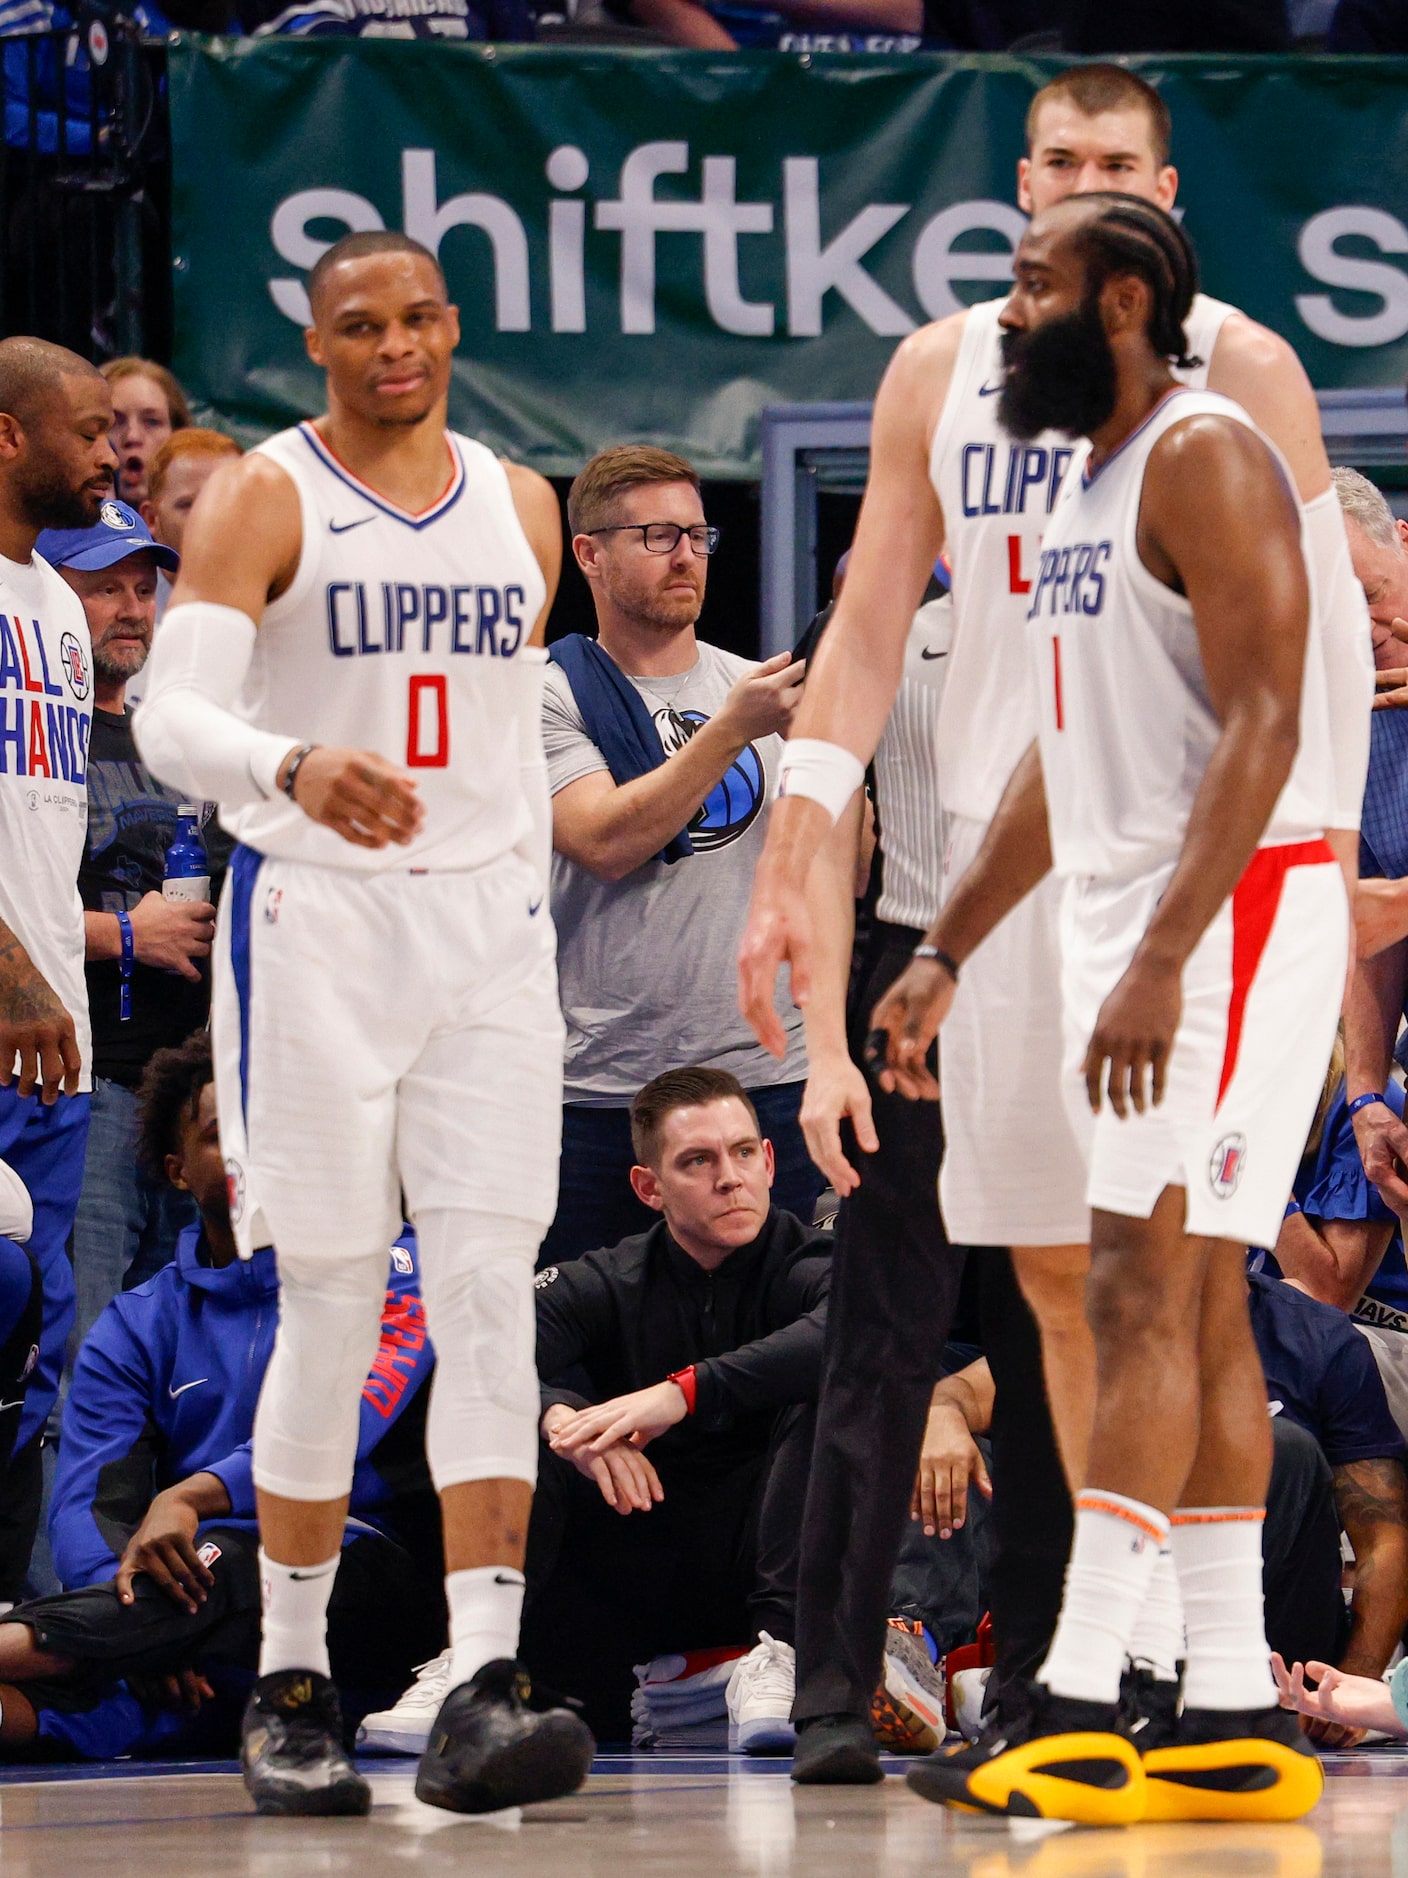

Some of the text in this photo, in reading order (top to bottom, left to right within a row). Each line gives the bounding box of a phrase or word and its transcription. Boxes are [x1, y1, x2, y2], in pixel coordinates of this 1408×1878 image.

[268, 140, 1185, 336] shiftke
[0, 614, 63, 697] ALL
[327, 582, 525, 658] CLIPPERS
[0, 697, 91, 786] HANDS
[407, 675, 448, 768] 0
